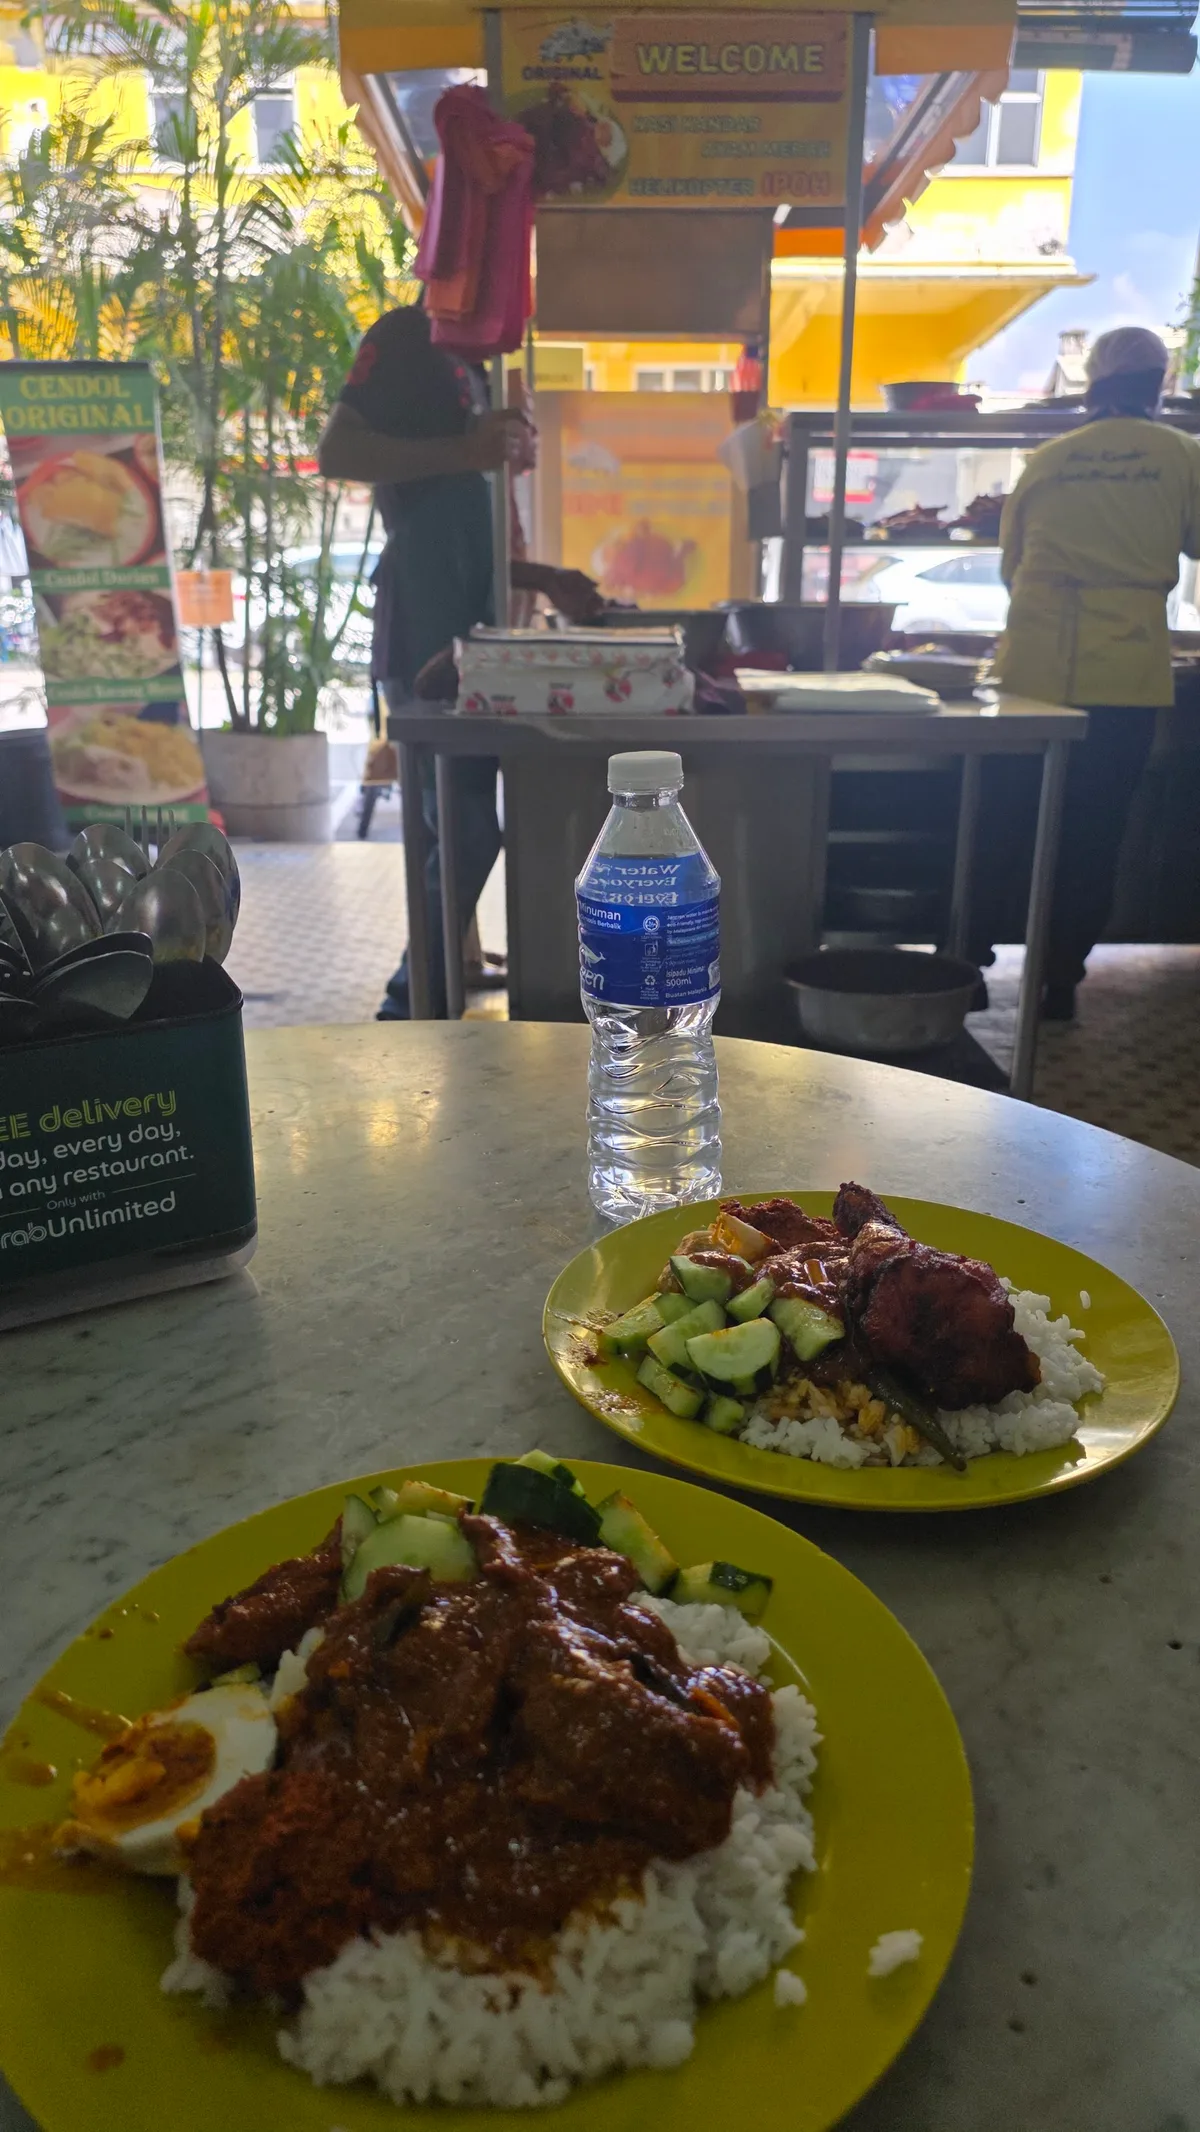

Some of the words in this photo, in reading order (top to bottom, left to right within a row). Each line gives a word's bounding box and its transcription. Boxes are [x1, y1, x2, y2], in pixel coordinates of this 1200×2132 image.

[637, 43, 826, 75] WELCOME
[521, 65, 605, 81] ORIGINAL
[760, 170, 831, 197] IPOH
[19, 374, 131, 399] CENDOL
[6, 404, 153, 430] ORIGINAL
[665, 977, 692, 987] 500ml
[39, 1090, 177, 1132] delivery
[53, 1132, 122, 1159] every
[128, 1122, 181, 1144] day,
[9, 1174, 57, 1196] any
[63, 1145, 195, 1186] restaurant.
[46, 1196, 77, 1211] Only
[79, 1190, 106, 1204] with
